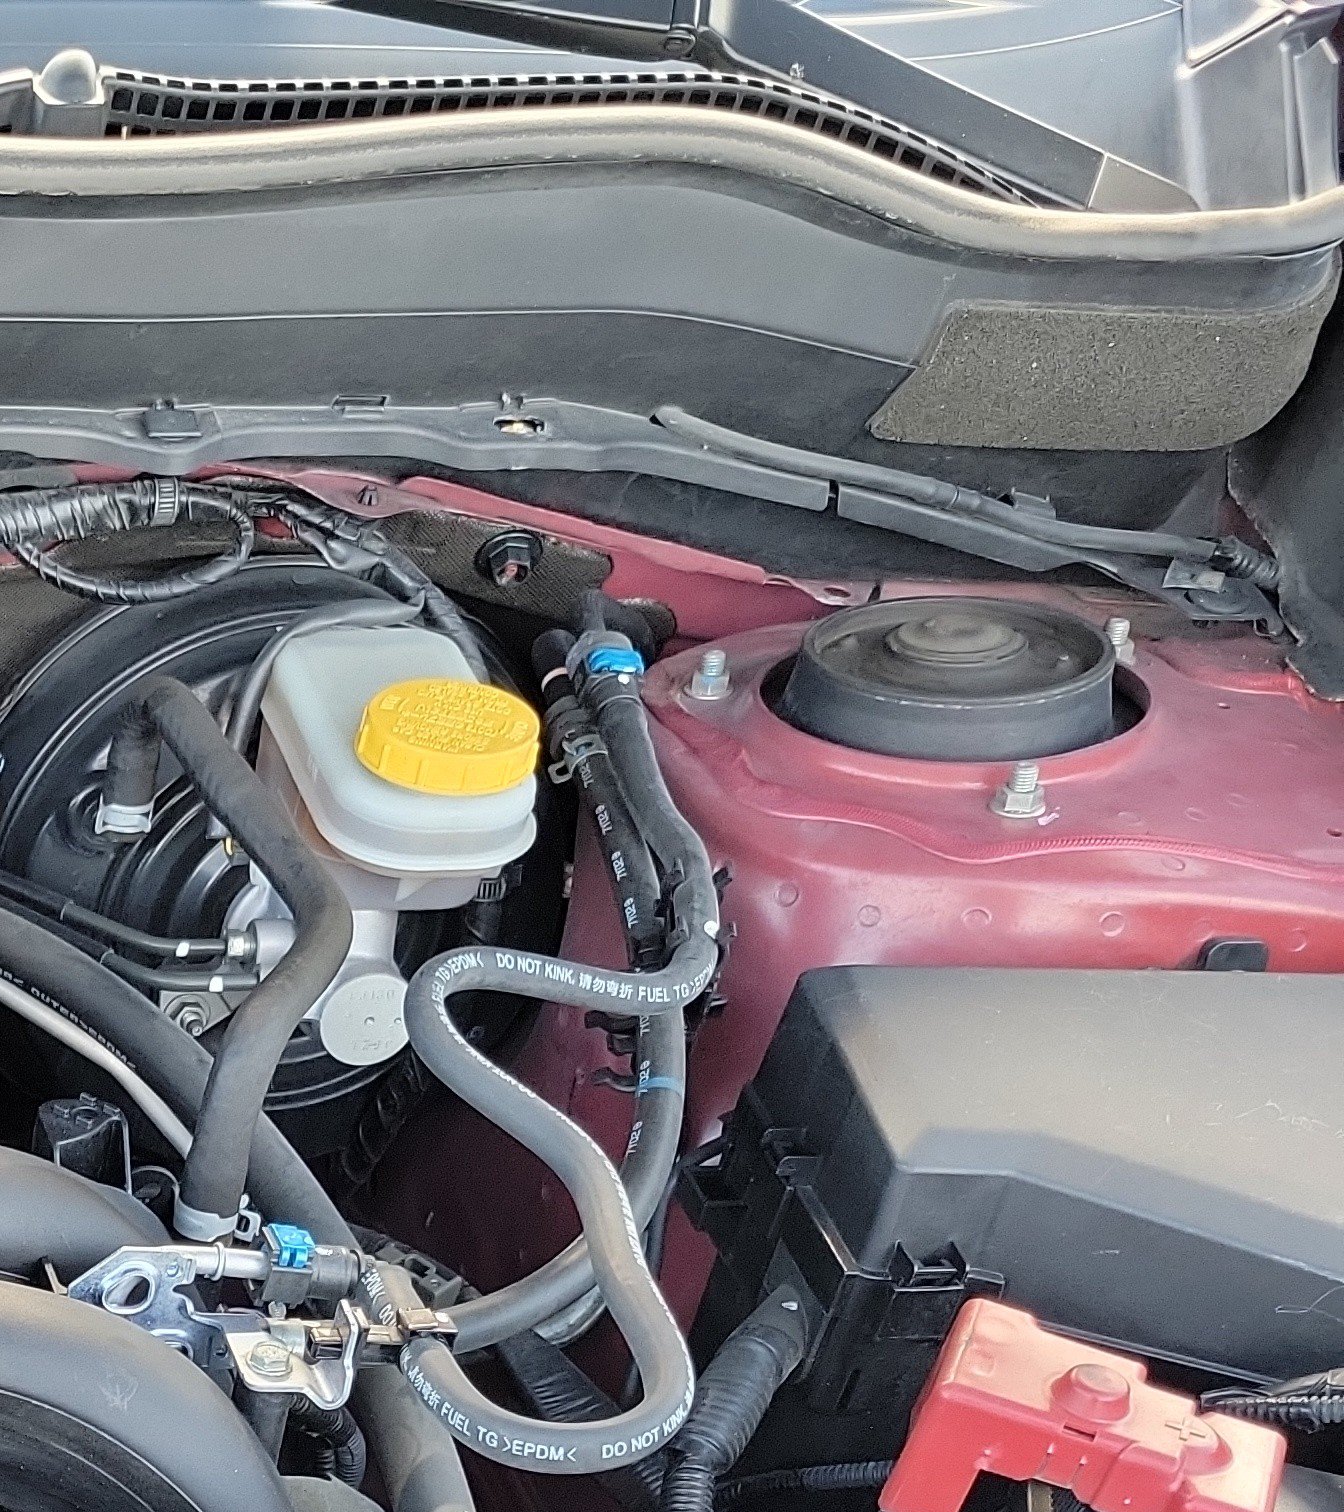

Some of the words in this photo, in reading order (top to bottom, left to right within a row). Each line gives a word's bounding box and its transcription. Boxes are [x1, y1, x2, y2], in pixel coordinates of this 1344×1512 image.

[495, 952, 515, 970] DO
[516, 955, 543, 975] NOT
[578, 972, 634, 1000] 请勿弯折
[637, 989, 671, 1003] FUEL
[672, 985, 690, 999] TG
[440, 1402, 472, 1438] FUEL
[476, 1425, 499, 1449] TG
[502, 1435, 578, 1462] >EPDM<
[601, 1441, 628, 1460] DO
[630, 1428, 661, 1454] NOT
